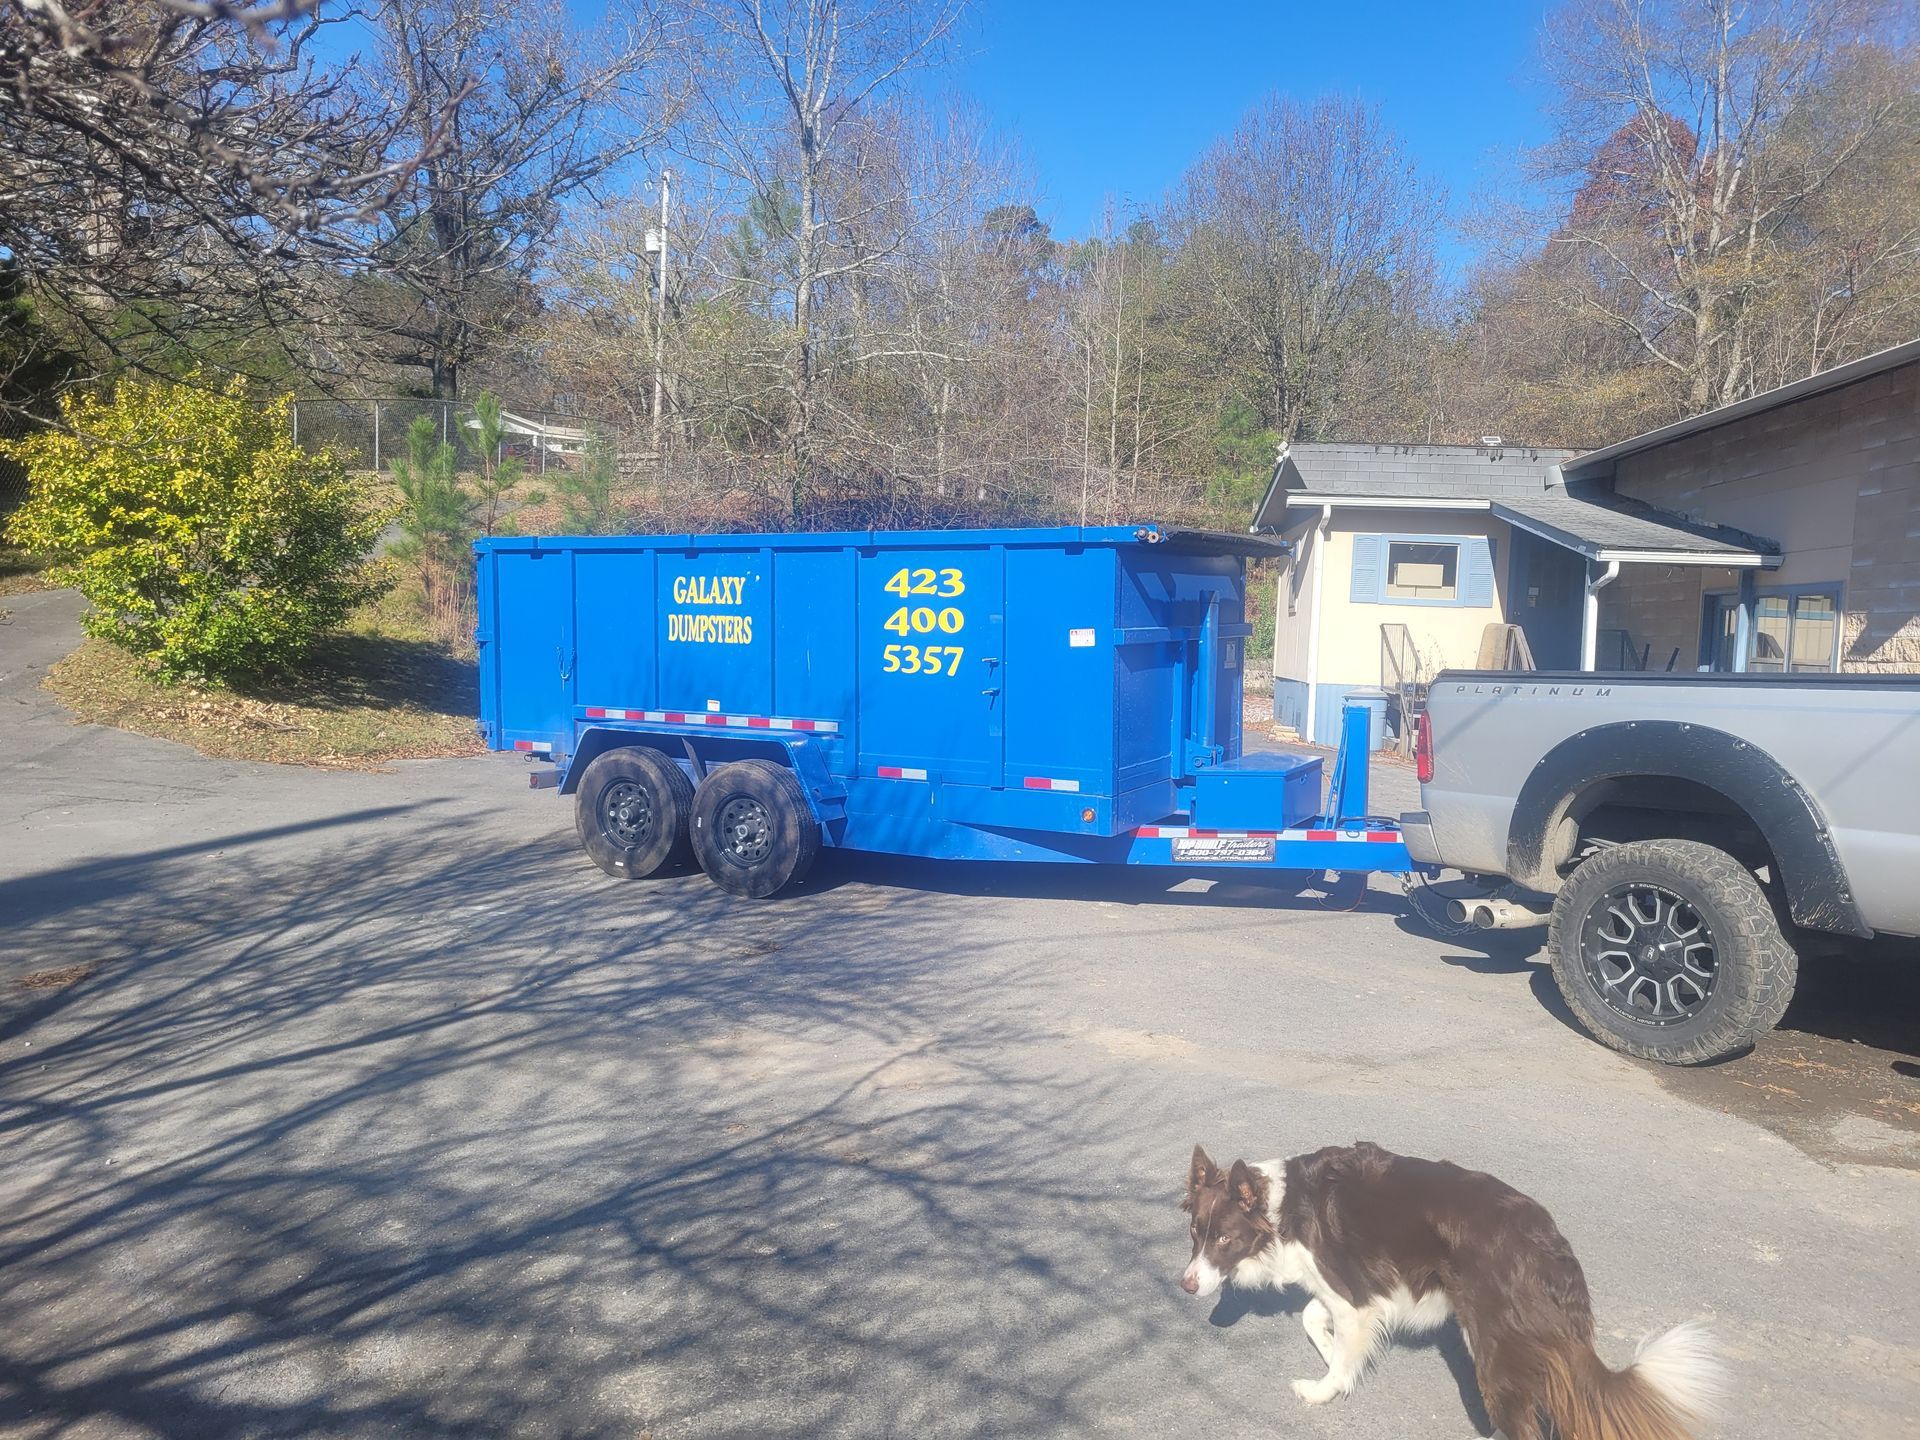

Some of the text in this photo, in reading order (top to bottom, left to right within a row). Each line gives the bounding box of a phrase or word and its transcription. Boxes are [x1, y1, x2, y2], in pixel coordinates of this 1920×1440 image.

[673, 576, 746, 605] GALAXY
[884, 568, 966, 598] 423
[668, 614, 753, 645] DUMPSTERS
[883, 606, 965, 637] 400
[883, 644, 964, 677] 5357
[1456, 686, 1612, 697] PLATINUM
